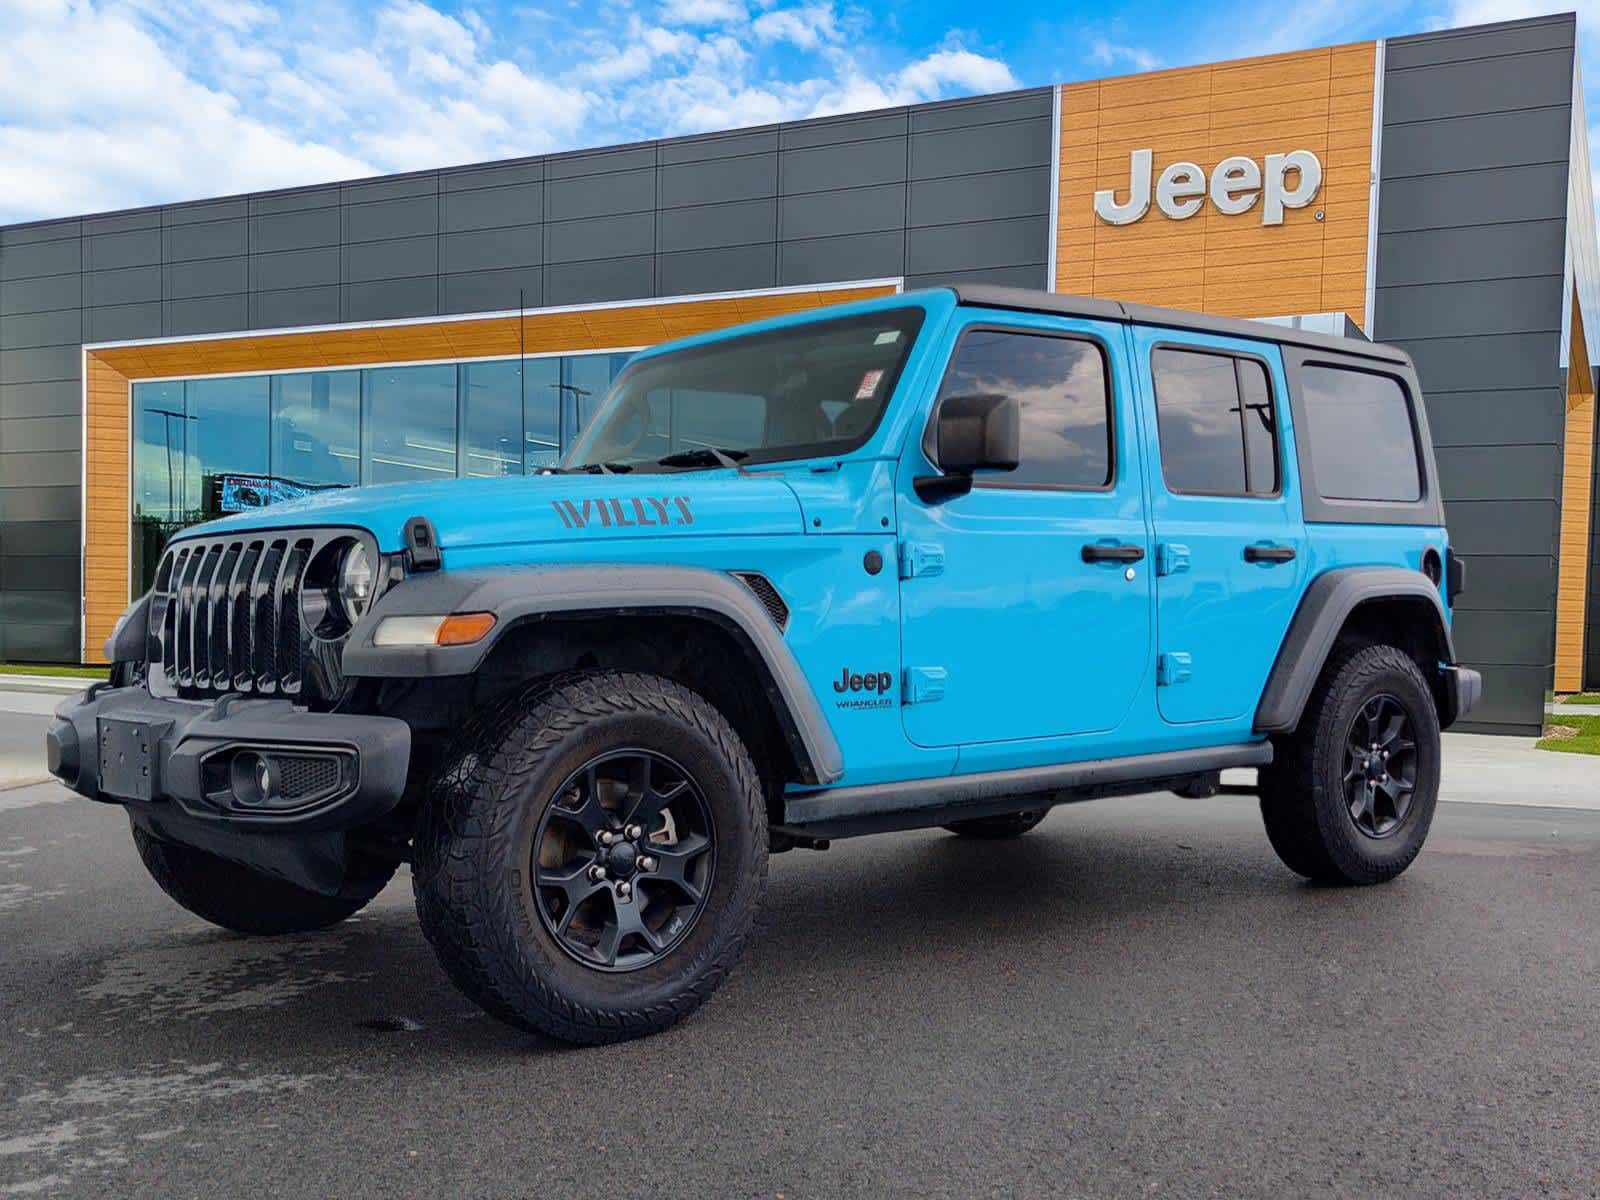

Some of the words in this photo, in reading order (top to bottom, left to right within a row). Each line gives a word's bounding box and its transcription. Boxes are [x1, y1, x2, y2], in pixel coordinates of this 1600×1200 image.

[1093, 148, 1322, 226] Jeep
[550, 496, 694, 528] WILLYS
[833, 667, 892, 695] Jeep
